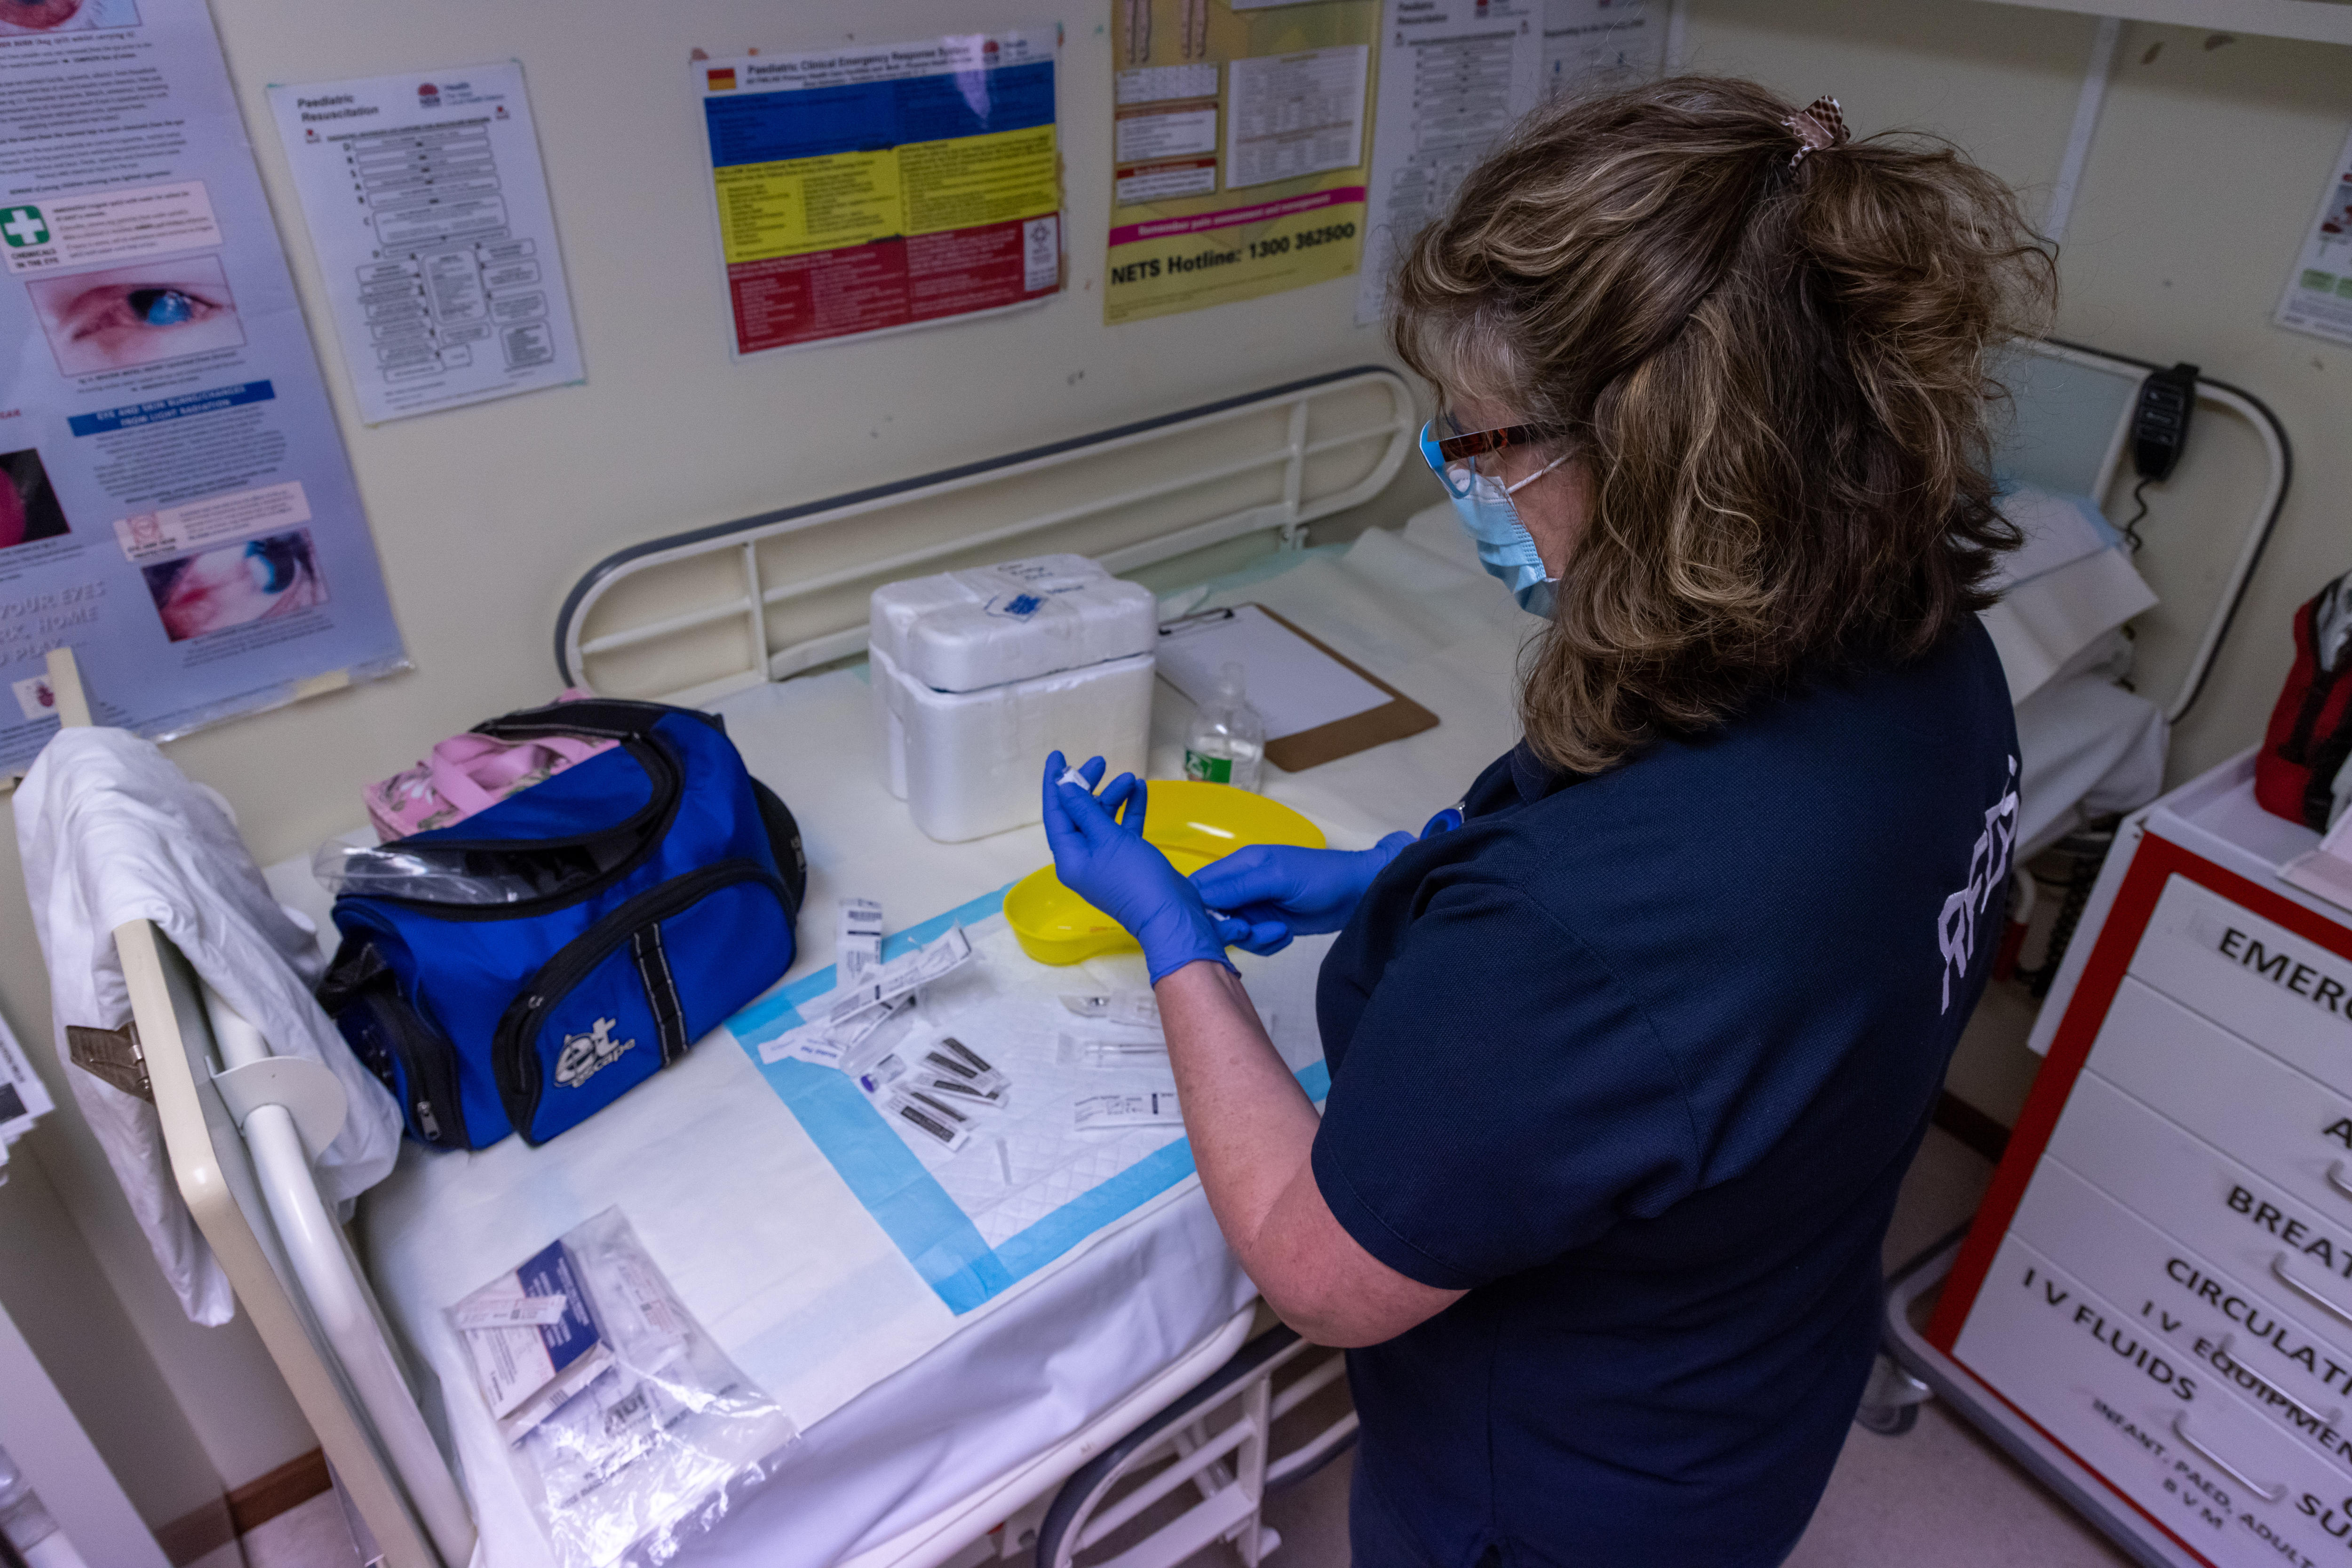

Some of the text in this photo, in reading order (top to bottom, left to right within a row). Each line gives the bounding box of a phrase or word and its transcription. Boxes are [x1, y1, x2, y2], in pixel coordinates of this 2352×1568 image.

[747, 64, 798, 75] Paediatric
[801, 59, 836, 71] Clinical
[837, 55, 889, 67] Emergency
[891, 50, 936, 61] Response
[297, 95, 354, 108] Paediatric
[301, 106, 379, 122] Resuscitation
[1137, 221, 1190, 235] Remember
[11, 248, 56, 260] CHEMICALS
[43, 257, 59, 265] EYE
[1111, 223, 1355, 284] NETS Hotline: 1300 362500
[117, 404, 139, 416] AND
[141, 399, 166, 412] SKIN
[120, 399, 232, 426] FROM LIGHT RADIATION
[1, 580, 108, 621] YOUR EYES
[40, 606, 99, 635] HOME
[2217, 927, 2352, 1022] EMER
[2161, 1312, 2184, 1332] V
[2046, 1281, 2069, 1305] V
[2074, 1305, 2199, 1402] FLUIDS
[2295, 1492, 2352, 1550] SU
